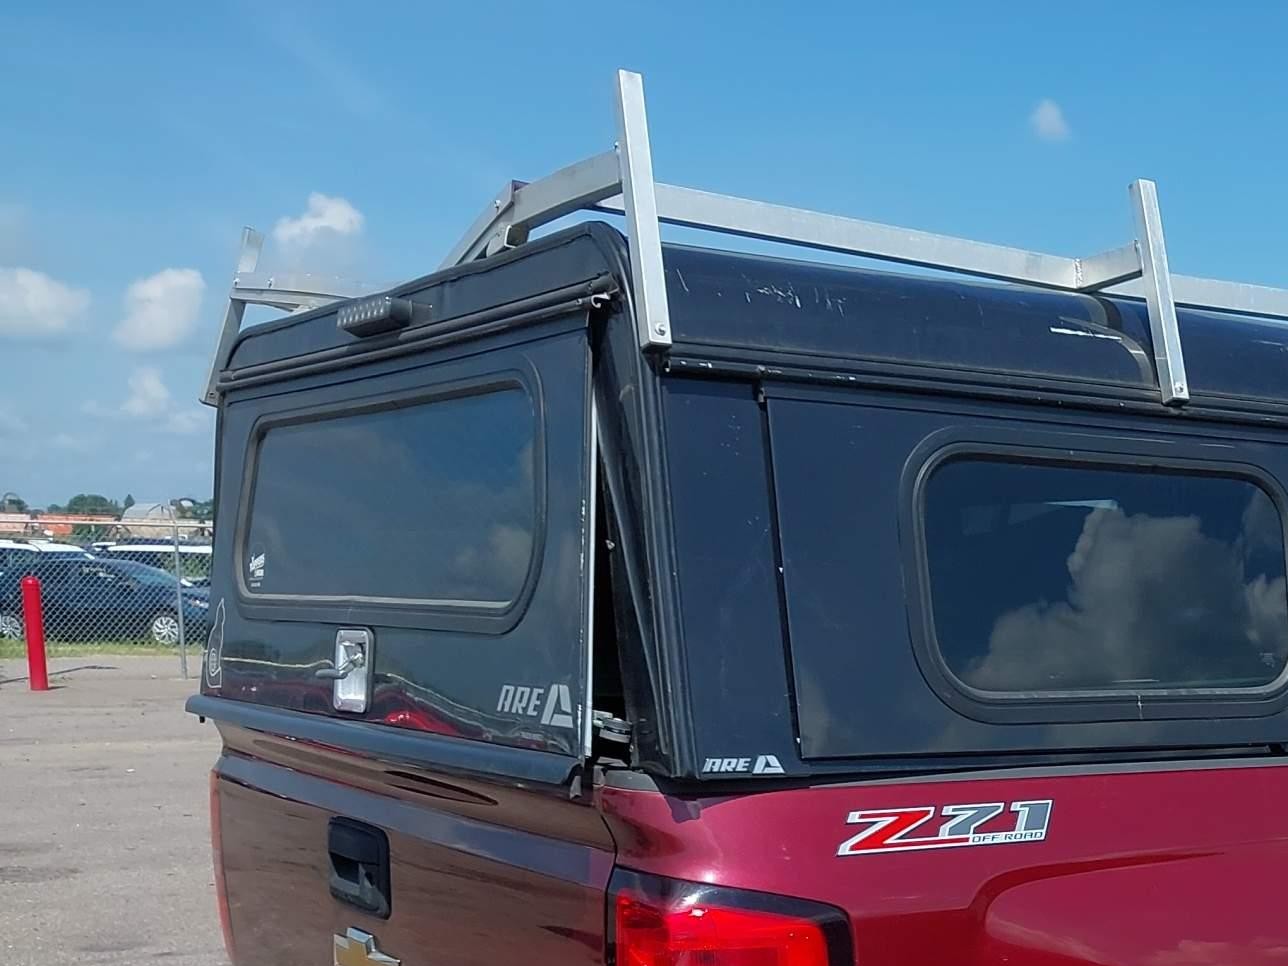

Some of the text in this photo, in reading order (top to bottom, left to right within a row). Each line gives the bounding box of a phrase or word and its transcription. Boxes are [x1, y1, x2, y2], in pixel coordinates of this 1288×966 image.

[836, 799, 1054, 856] Z71
[971, 830, 1044, 844] OFF ROAD
